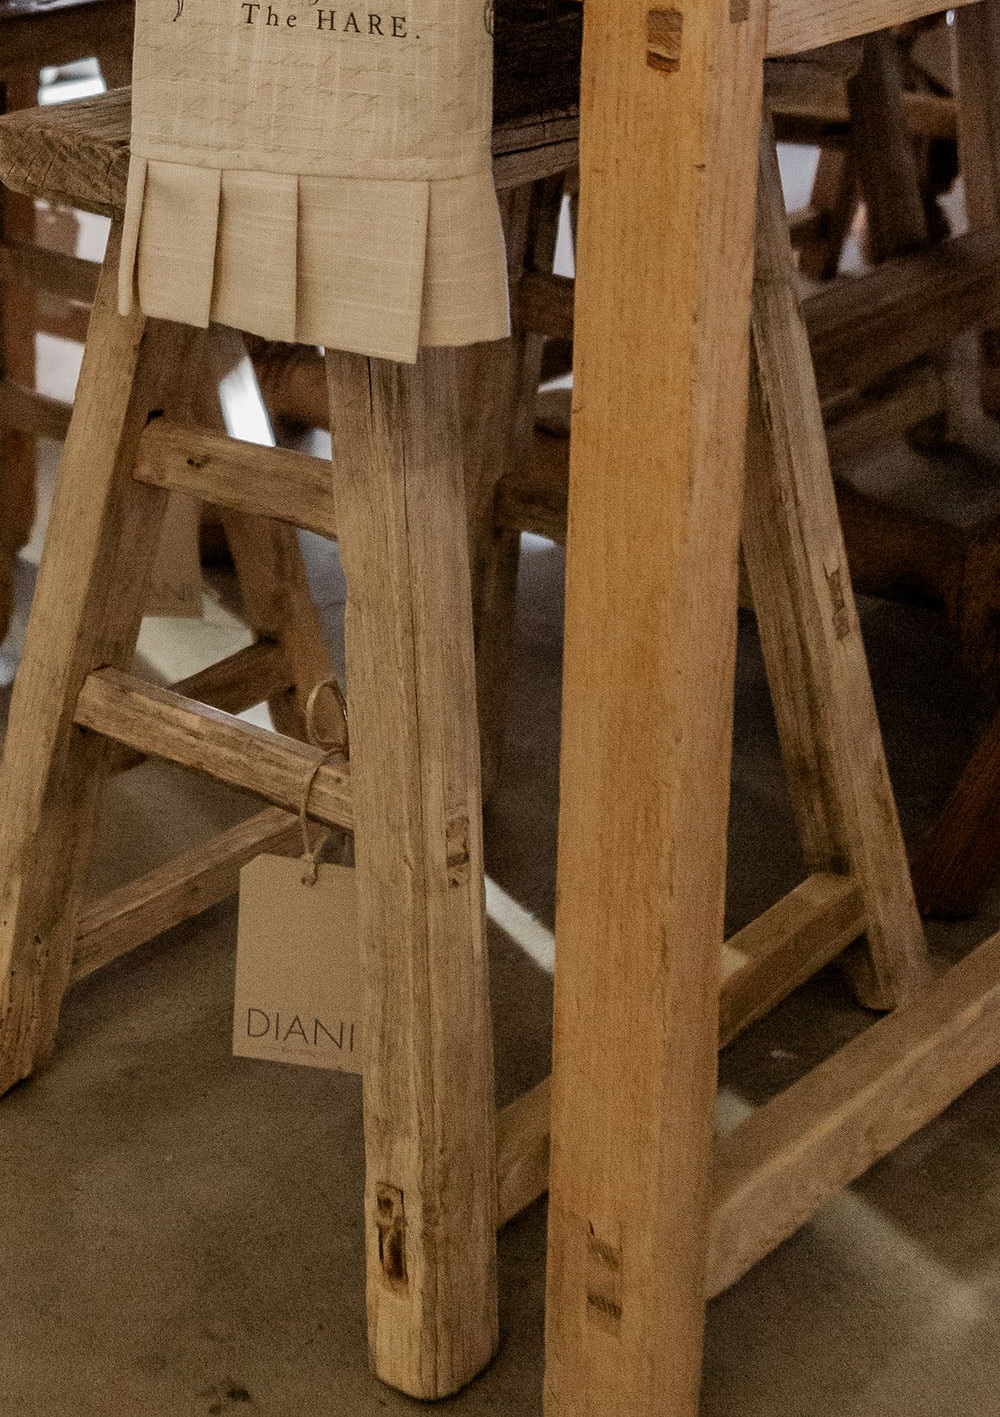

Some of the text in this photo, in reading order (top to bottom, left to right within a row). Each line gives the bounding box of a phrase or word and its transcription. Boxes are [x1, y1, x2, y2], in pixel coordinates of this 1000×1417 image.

[241, 2, 421, 40] The HARE.
[246, 1007, 355, 1053] DIANI
